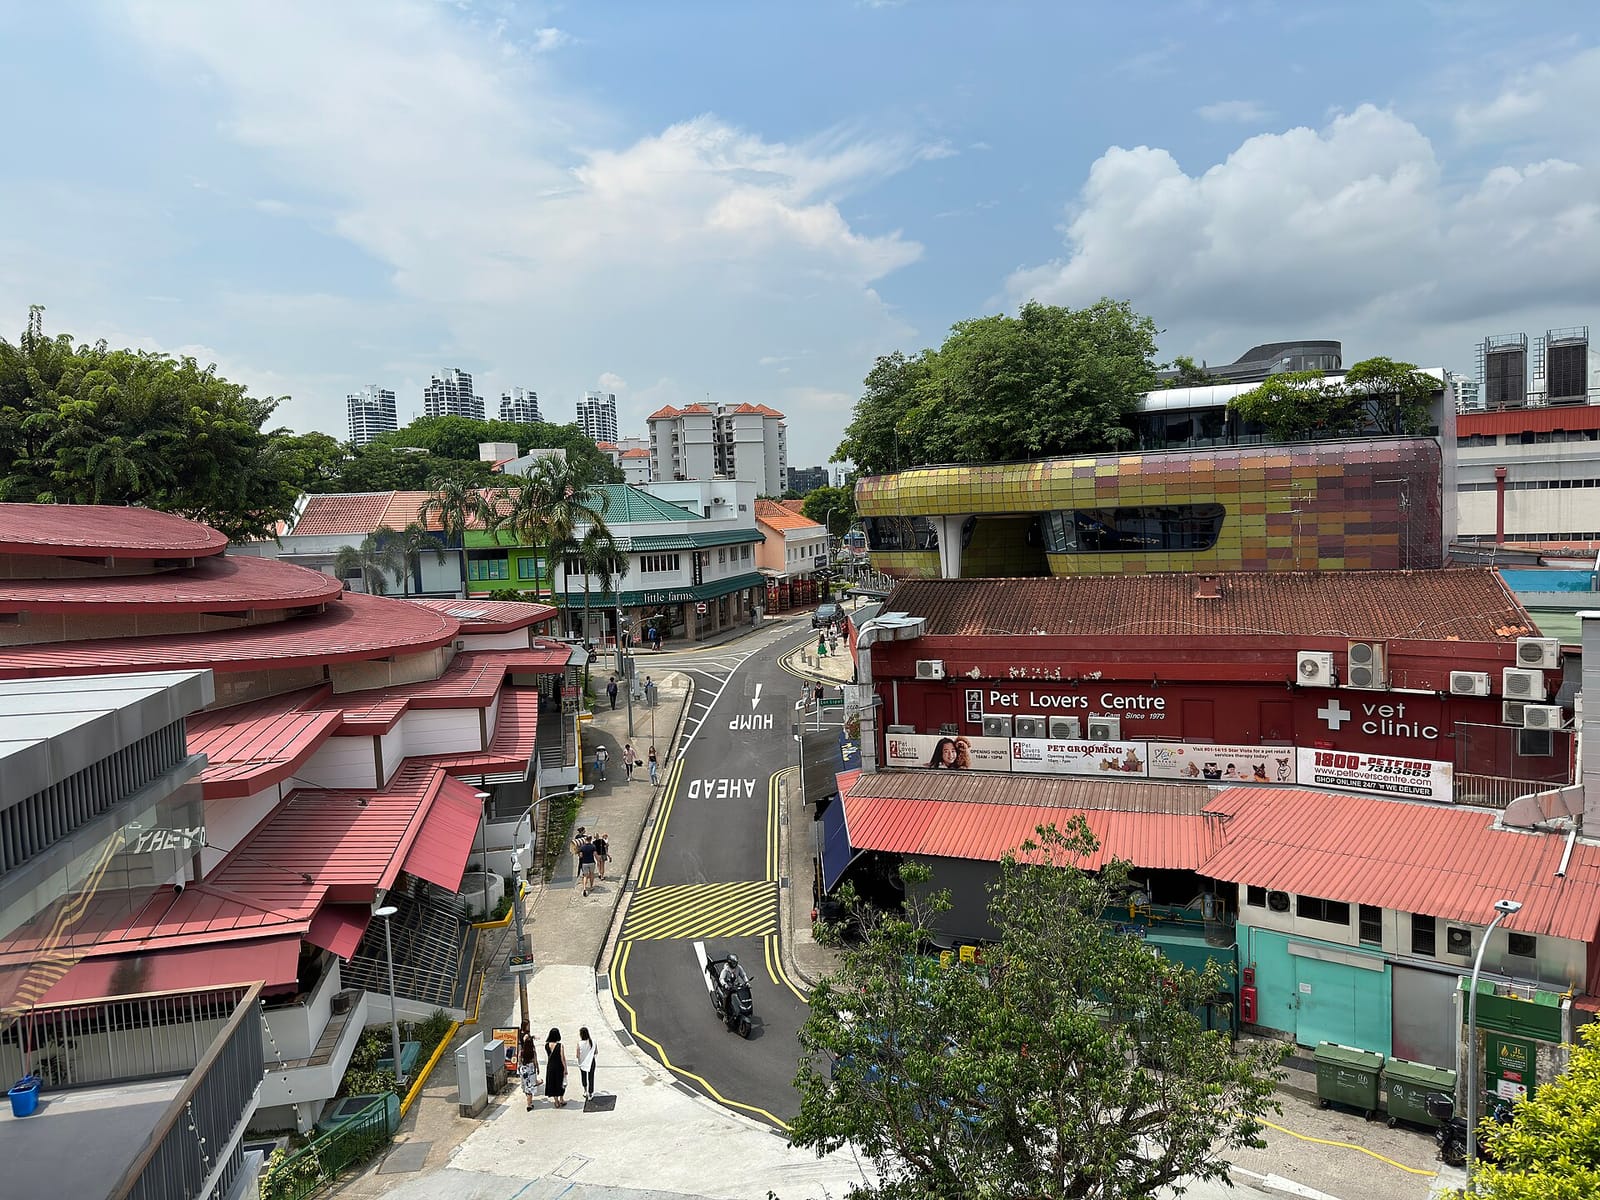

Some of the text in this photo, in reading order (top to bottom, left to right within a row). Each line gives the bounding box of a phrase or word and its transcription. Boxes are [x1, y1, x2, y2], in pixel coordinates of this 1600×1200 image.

[644, 591, 694, 603] little farms
[990, 690, 1166, 710] Pet Lovers Centre
[1125, 712, 1145, 720] Since
[1149, 712, 1165, 720] 1973
[1362, 702, 1406, 719] vet
[729, 713, 773, 730] HUMP
[1362, 719, 1439, 739] clinic
[1047, 744, 1066, 752] PET
[1314, 767, 1432, 787] www.petloverscentre.com
[1367, 764, 1431, 778] 7383663
[687, 778, 756, 799] AHEAD
[1316, 775, 1431, 796] SHOP ONLINE 24/7 WE DELIVER
